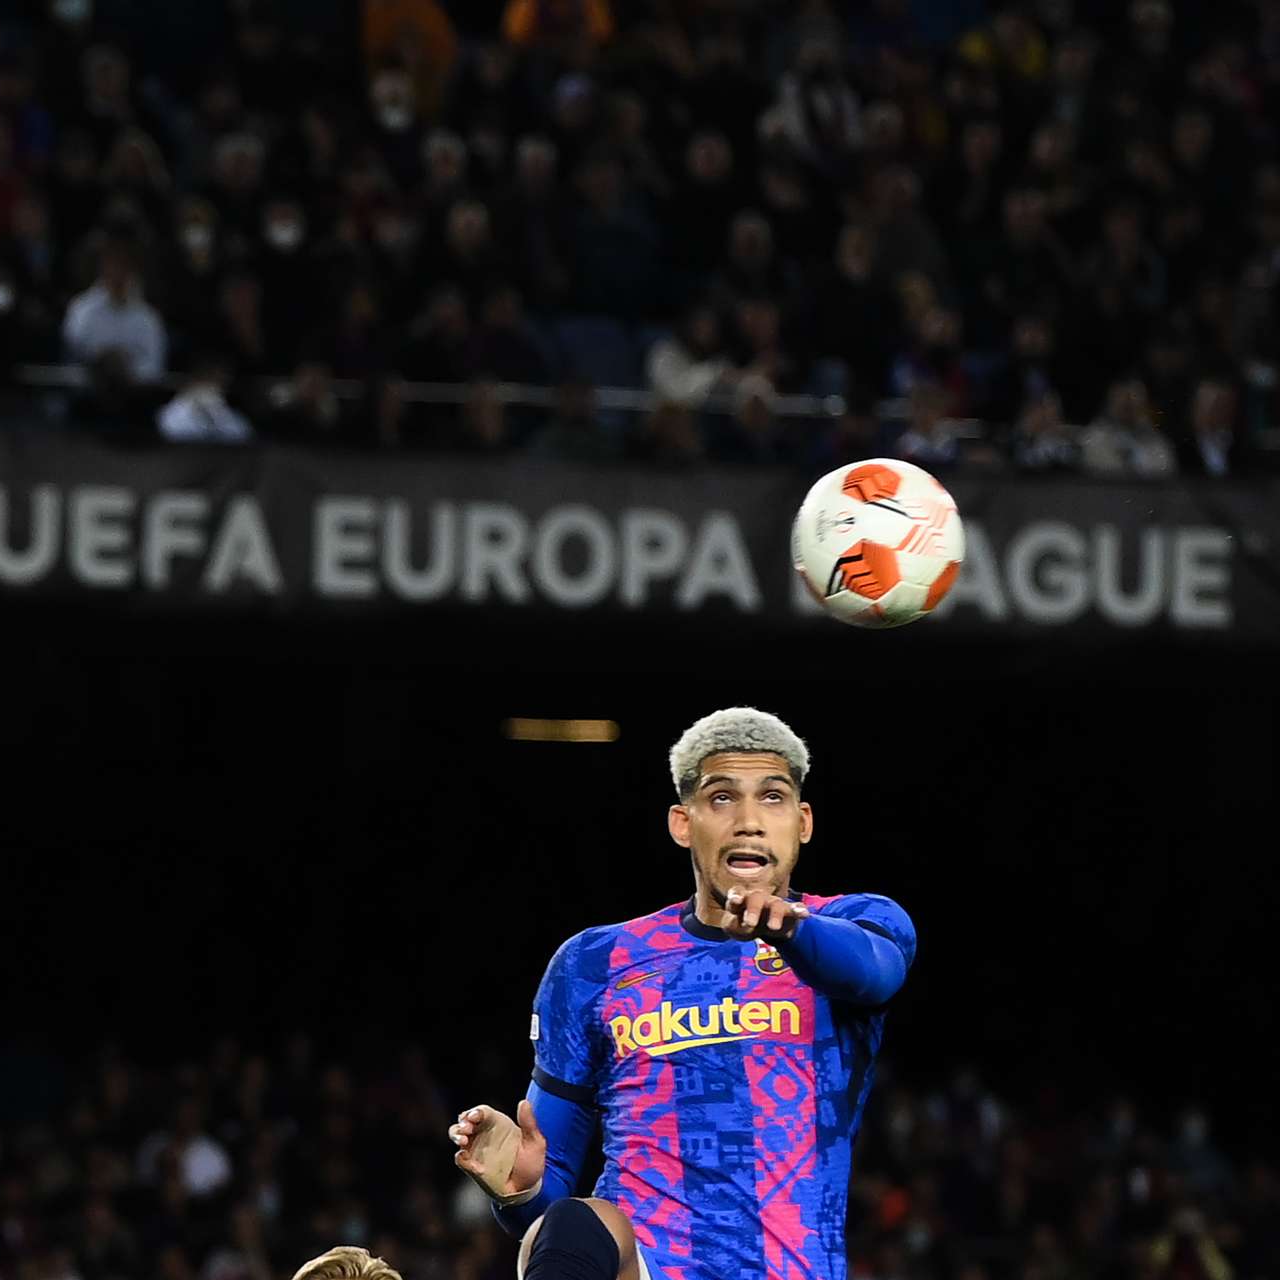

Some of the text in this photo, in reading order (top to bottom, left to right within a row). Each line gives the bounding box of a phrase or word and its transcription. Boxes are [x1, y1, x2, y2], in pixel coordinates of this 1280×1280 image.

[312, 494, 760, 611] EUROPA
[791, 520, 1232, 630] AGUE
[609, 997, 801, 1058] Rakuten
